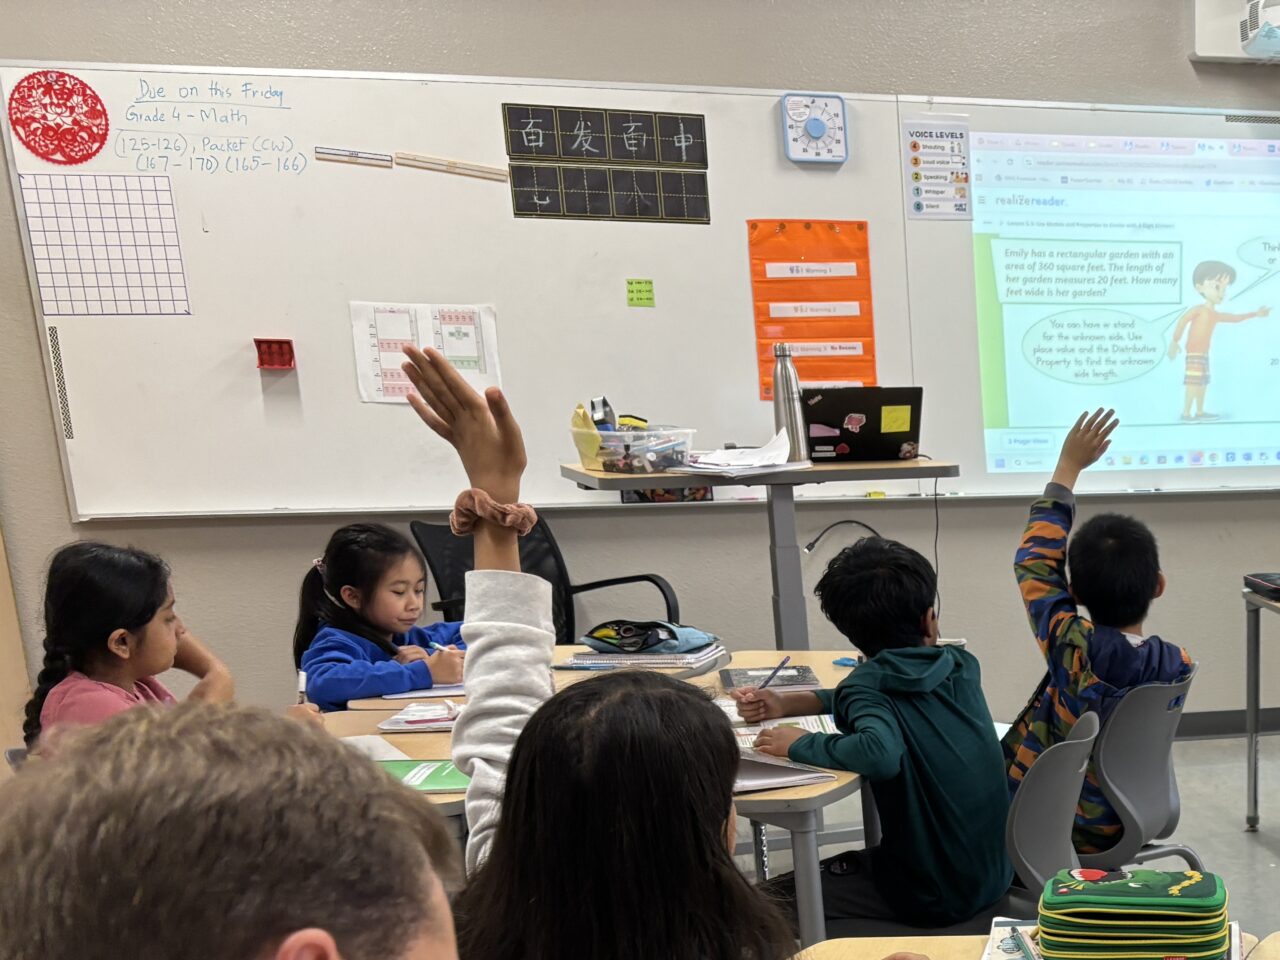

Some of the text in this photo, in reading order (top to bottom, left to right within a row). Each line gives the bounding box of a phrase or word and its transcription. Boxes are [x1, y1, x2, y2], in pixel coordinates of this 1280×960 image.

[136, 78, 284, 106] Due on this Friday
[125, 105, 166, 122] Grade
[172, 107, 180, 121] 4
[200, 108, 249, 126] Math
[909, 130, 964, 139] VOICE LEVELS
[202, 136, 249, 152] Packet
[252, 135, 294, 154] (CW)
[1005, 248, 1029, 260] Emily
[1031, 248, 1046, 257] has
[1057, 249, 1106, 261] rectangular
[1109, 250, 1139, 261] garden
[1141, 250, 1161, 259] with
[1027, 261, 1036, 272] of
[1038, 262, 1054, 271] 360
[1056, 263, 1085, 273] square
[1087, 262, 1106, 273] feet.
[1108, 262, 1124, 271] The
[1126, 263, 1153, 274] length
[1155, 262, 1164, 274] of
[1006, 275, 1178, 287] her garden measures 20 feet. How many
[1006, 287, 1107, 299] feet wide is her garden?
[1050, 319, 1064, 328] You
[1083, 319, 1100, 328] have
[1113, 319, 1135, 328] stand
[1042, 332, 1054, 340] for
[1058, 332, 1069, 340] the
[1072, 332, 1106, 341] unknown
[1127, 332, 1143, 340] Use
[1033, 344, 1157, 356] place value and the Distributive
[1035, 357, 1155, 369] Property to find the unknown
[1074, 369, 1089, 378] side
